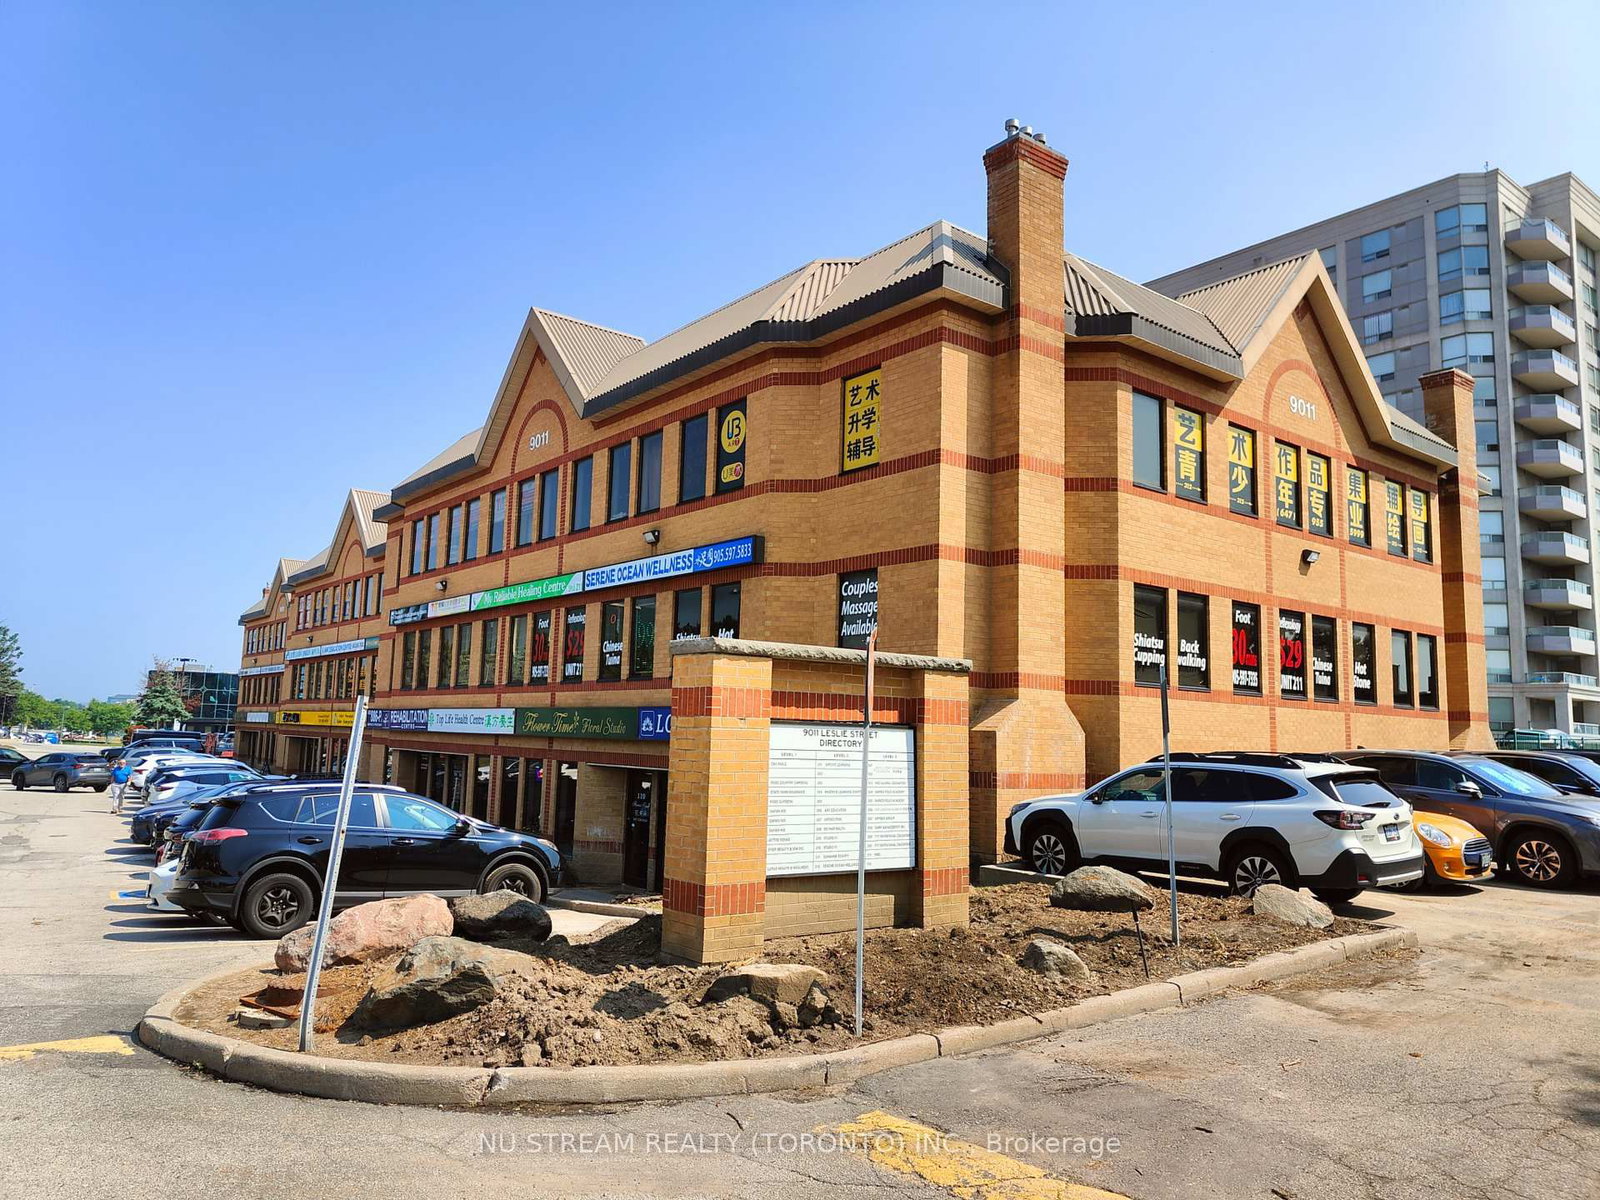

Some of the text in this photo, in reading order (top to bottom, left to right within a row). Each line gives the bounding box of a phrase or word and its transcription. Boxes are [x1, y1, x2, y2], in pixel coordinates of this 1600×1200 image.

[849, 379, 880, 407] 艺术
[1290, 395, 1315, 420] 9011
[848, 406, 876, 435] 升学
[530, 430, 549, 451] 9011
[846, 435, 876, 461] 辅导
[586, 568, 616, 587] SERENE
[616, 563, 644, 583] OCEAN
[646, 553, 693, 576] WELLNESS
[518, 586, 542, 599] Healing
[542, 580, 566, 594] Centre
[842, 578, 878, 598] Couples
[841, 601, 878, 617] Massage
[538, 618, 549, 629] Foot
[1235, 610, 1251, 625] Foot
[718, 628, 734, 640] Hot
[1134, 633, 1164, 650] Shiatsu
[602, 640, 624, 652] Chinese
[1180, 639, 1200, 654] Back
[1134, 648, 1166, 667] Cupping
[1355, 661, 1367, 676] Hot
[391, 710, 428, 723] REHABILITATION
[436, 714, 484, 726] Top Life Health Centre
[522, 712, 626, 735] Flower Time Floral Studio
[803, 728, 878, 739] 9011 LESLIE STRET
[820, 739, 862, 748] DIRECTORY
